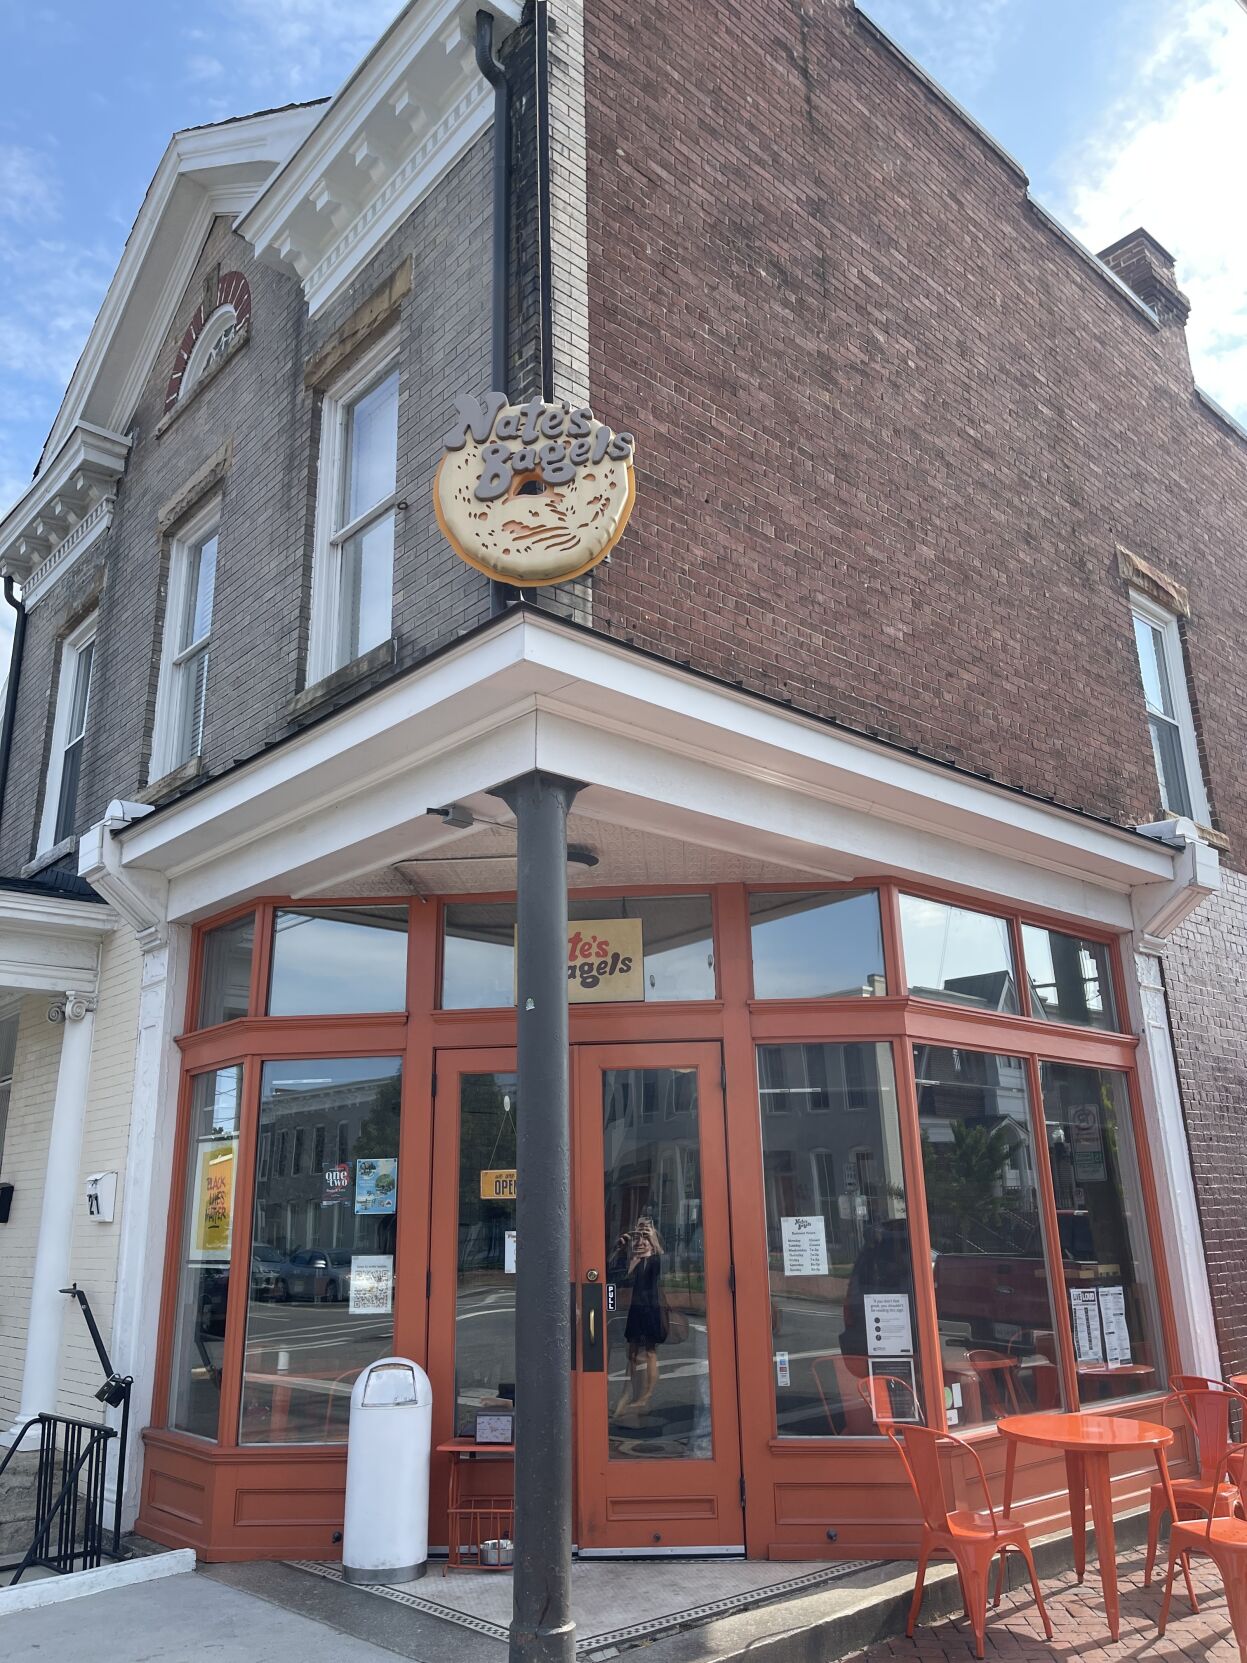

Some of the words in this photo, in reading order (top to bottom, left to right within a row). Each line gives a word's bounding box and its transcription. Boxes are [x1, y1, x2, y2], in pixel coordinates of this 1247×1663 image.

[444, 391, 593, 451] Nate's
[474, 426, 635, 502] Bagels
[568, 931, 609, 962] te's
[568, 952, 632, 988] agels
[206, 1176, 226, 1191] BLACK
[325, 1171, 347, 1180] one
[327, 1179, 348, 1187] two
[494, 1180, 516, 1195] OPE
